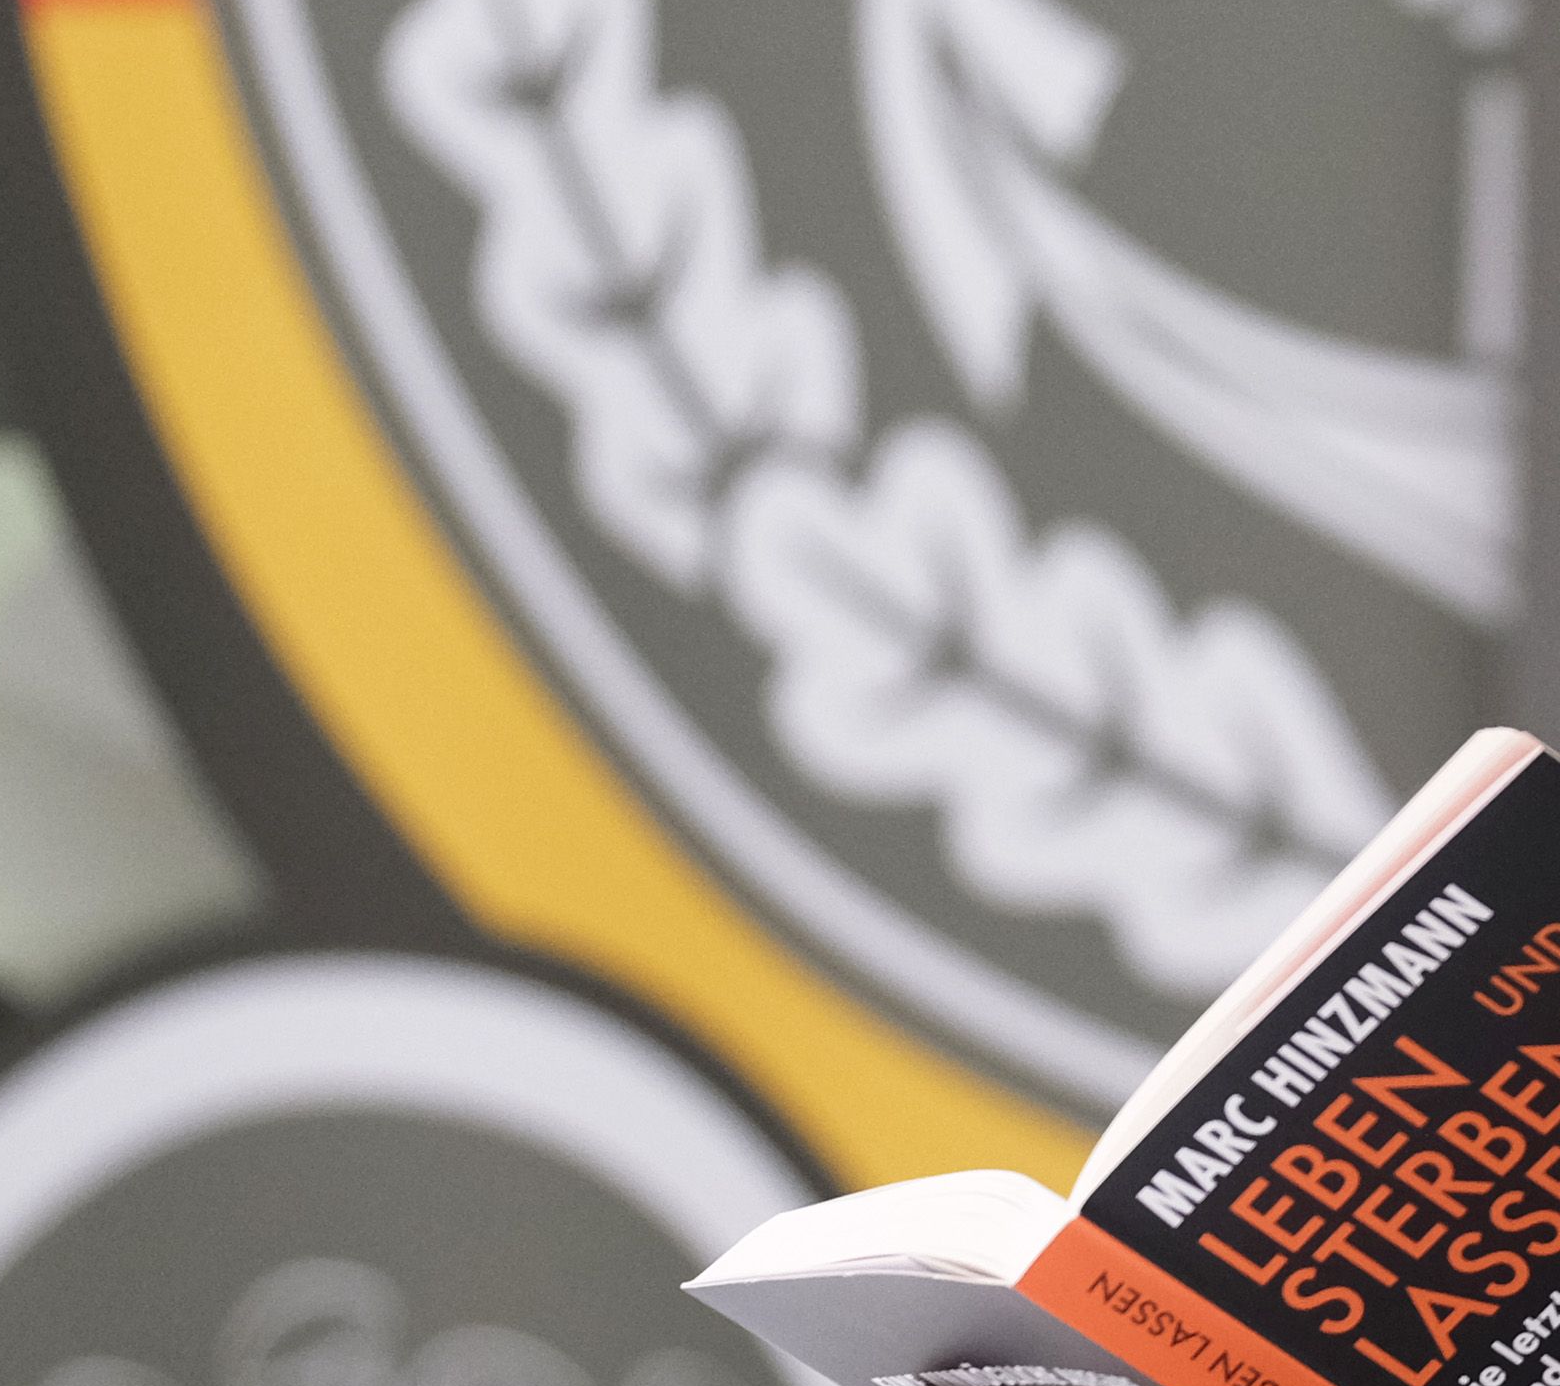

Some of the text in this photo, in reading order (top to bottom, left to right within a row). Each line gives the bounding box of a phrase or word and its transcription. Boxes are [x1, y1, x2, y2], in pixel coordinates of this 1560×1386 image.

[1136, 881, 1495, 1229] MARC HINZMANN
[1197, 1034, 1472, 1286] LEBEN
[1083, 1268, 1213, 1361] LASSEN
